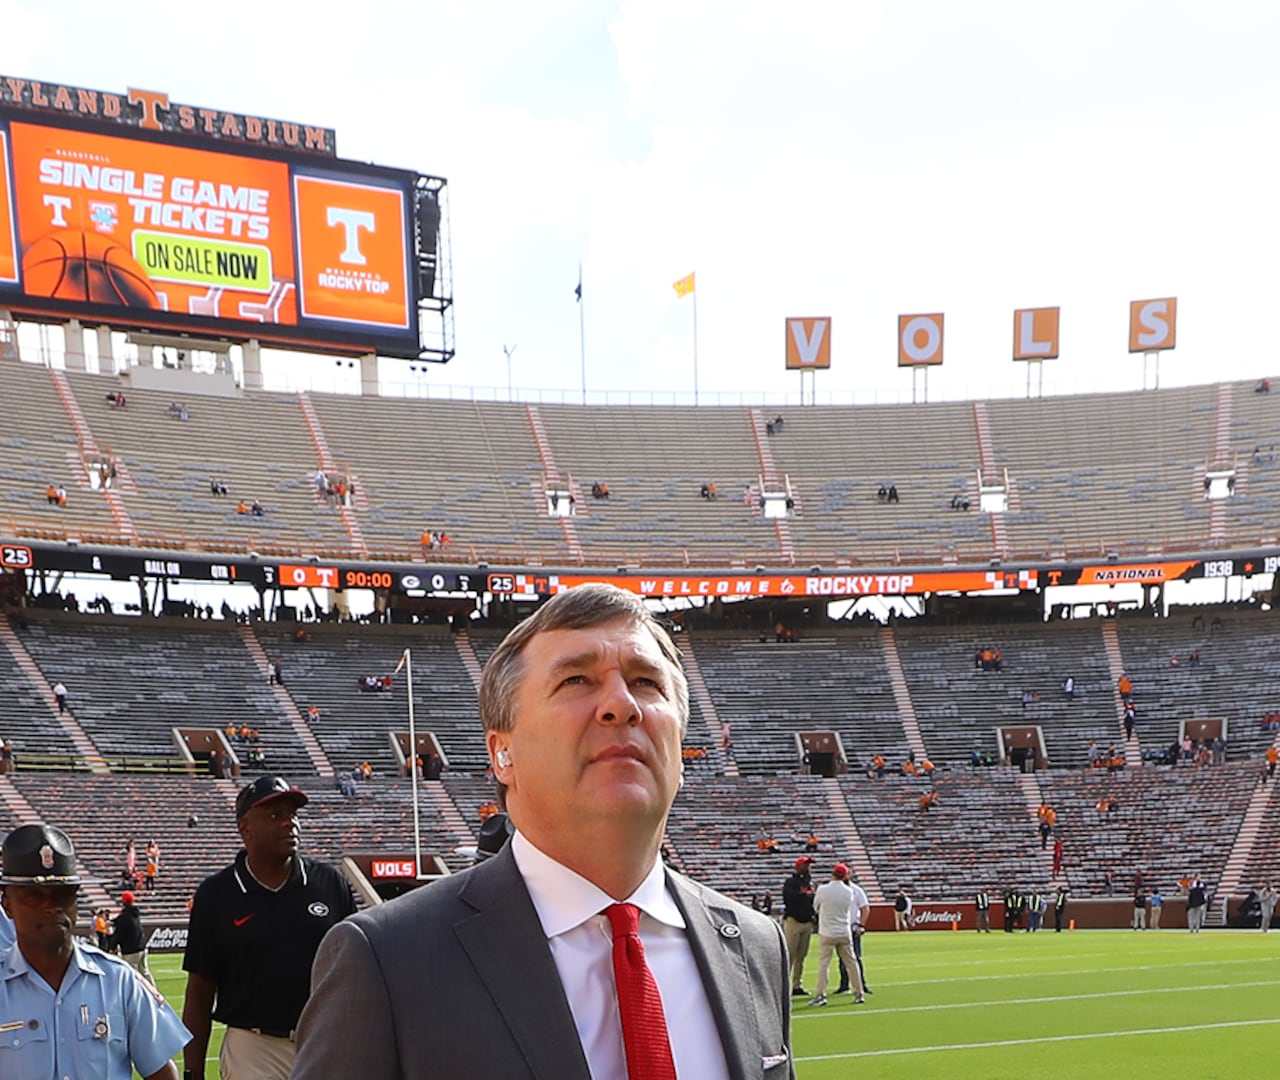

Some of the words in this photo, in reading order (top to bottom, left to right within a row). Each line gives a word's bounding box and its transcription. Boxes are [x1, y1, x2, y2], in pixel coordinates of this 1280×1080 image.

[179, 106, 326, 150] STADIUM
[39, 158, 165, 198] SINGLE
[170, 177, 269, 213] GAME
[43, 195, 72, 226] T
[128, 197, 270, 239] TICKETS
[326, 206, 376, 265] T
[146, 241, 170, 271] ON
[174, 246, 213, 276] SALE
[216, 252, 258, 280] NOW
[318, 273, 362, 291] ROCKY
[364, 279, 390, 295] TOP
[3, 548, 29, 564] 25
[345, 571, 392, 587] 90:00
[1094, 567, 1165, 581] NATIONAL
[1203, 560, 1234, 577] 1938
[491, 578, 513, 591] 25
[639, 579, 771, 596] WELCOME
[780, 578, 795, 596] to
[805, 576, 872, 595] ROCKY
[875, 575, 914, 594] TOP
[374, 862, 413, 876] VOLS
[914, 909, 962, 924] Hardee's
